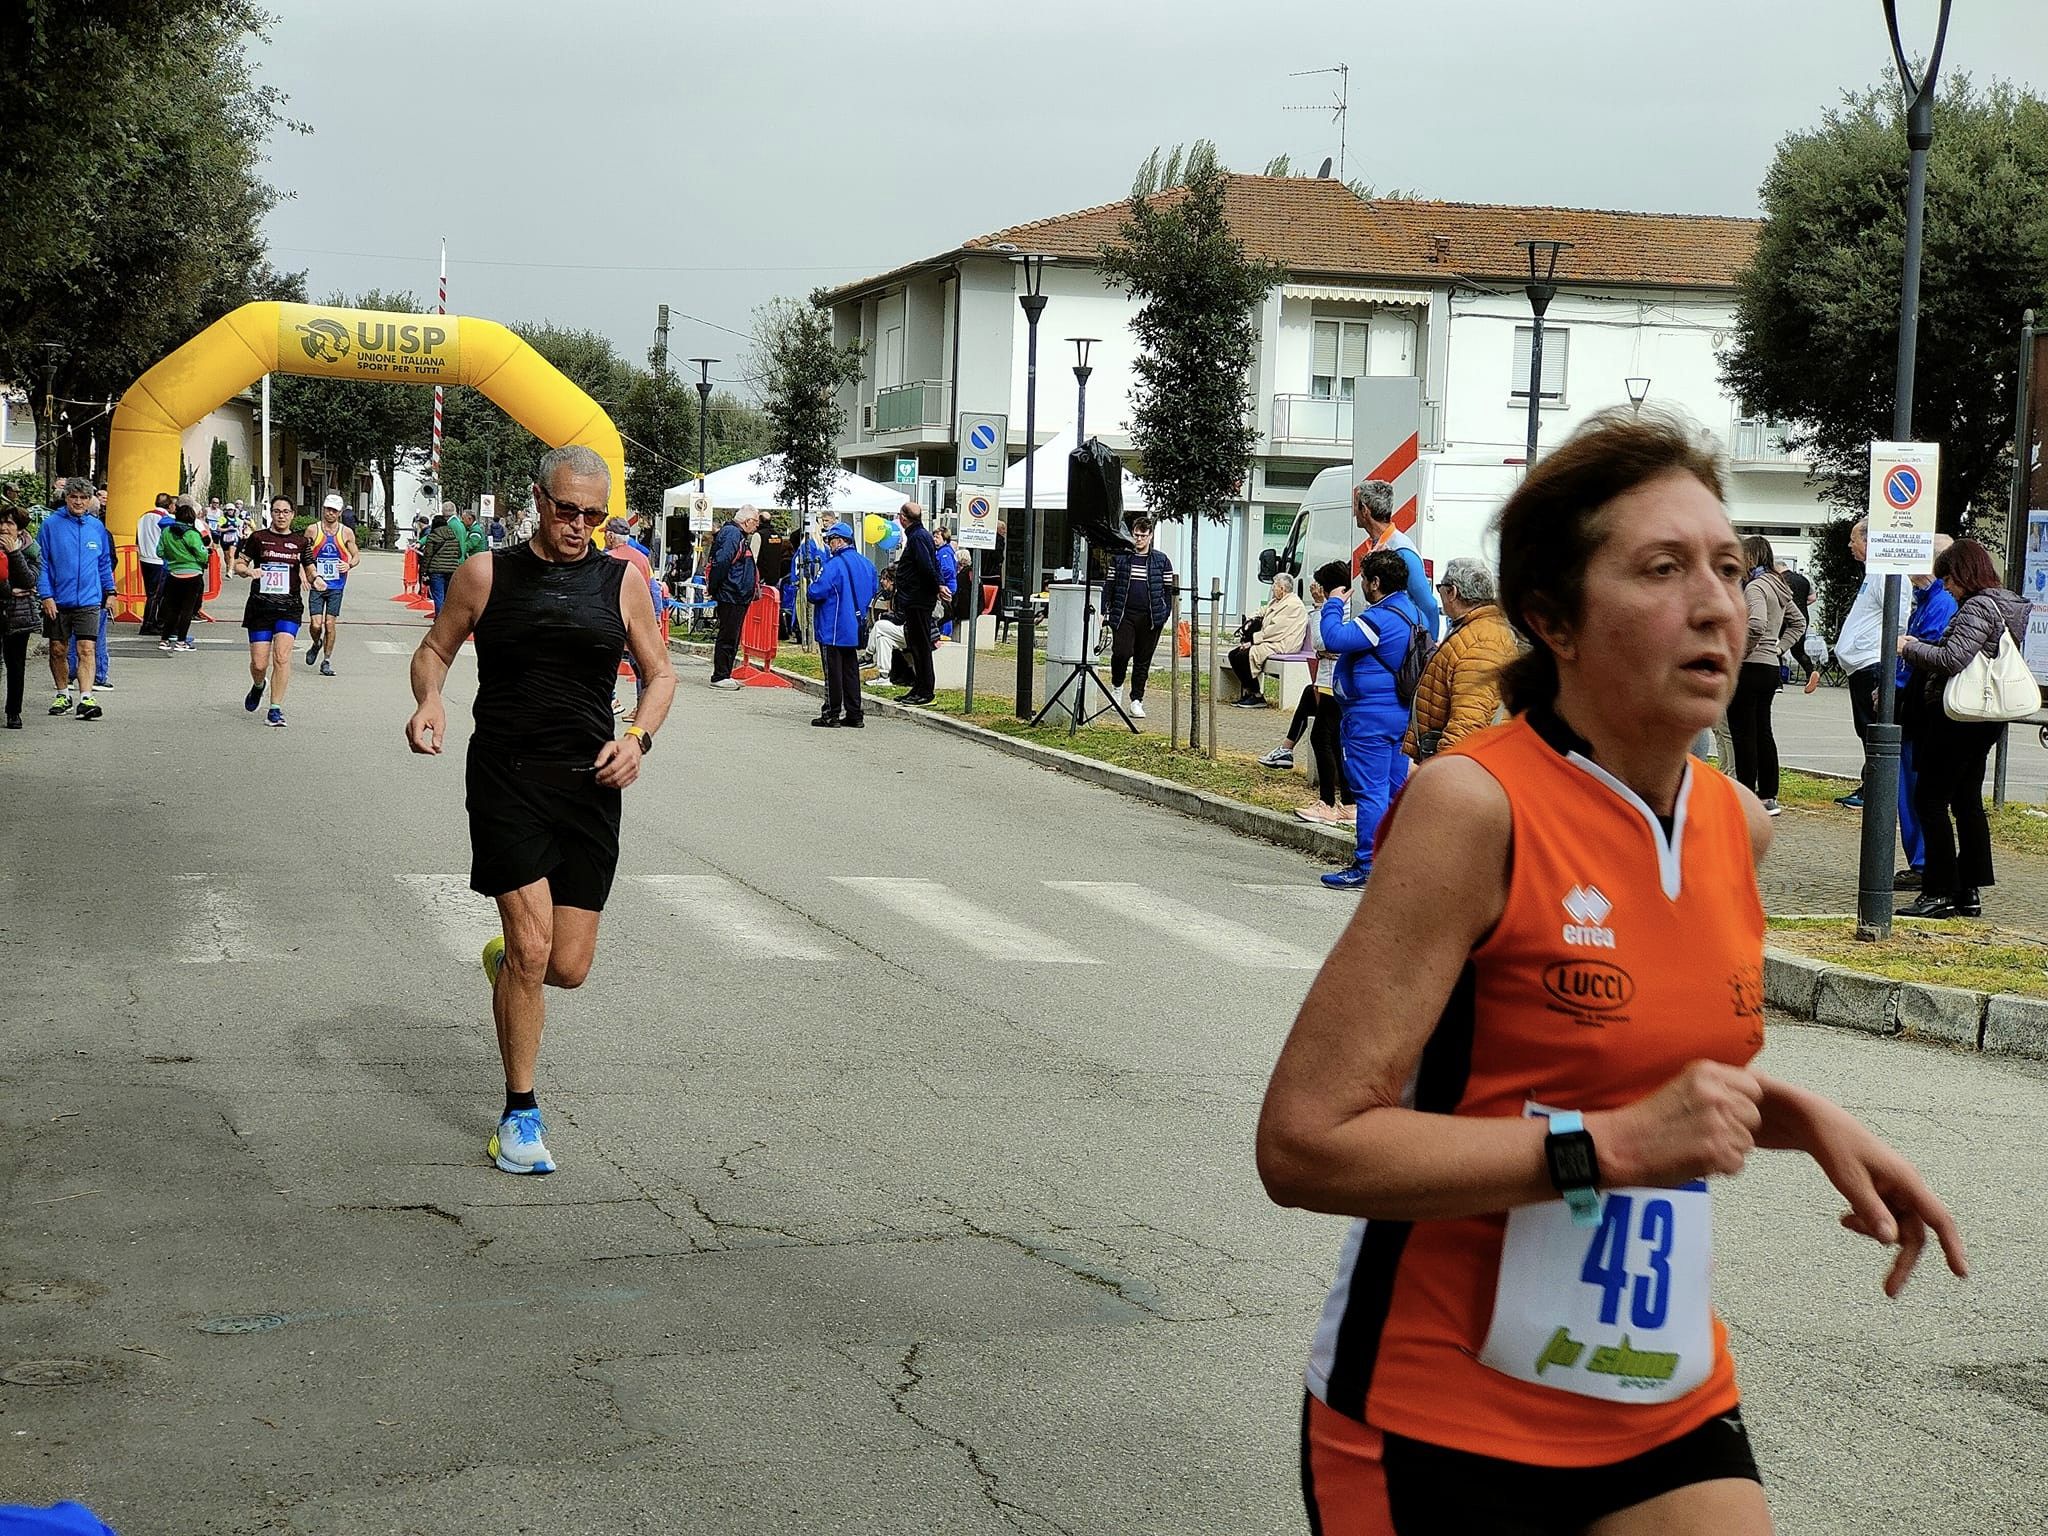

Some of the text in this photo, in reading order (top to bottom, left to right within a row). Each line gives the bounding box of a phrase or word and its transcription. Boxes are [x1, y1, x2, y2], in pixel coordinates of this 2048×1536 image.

[357, 321, 446, 354] UISP
[357, 352, 446, 367] UNIONE ITALIANA
[357, 361, 440, 375] SPORT PER TUTTI
[324, 564, 334, 574] 99
[266, 572, 283, 586] 231
[1557, 966, 1625, 1000] LUCCI
[1580, 1192, 1674, 1330] 43
